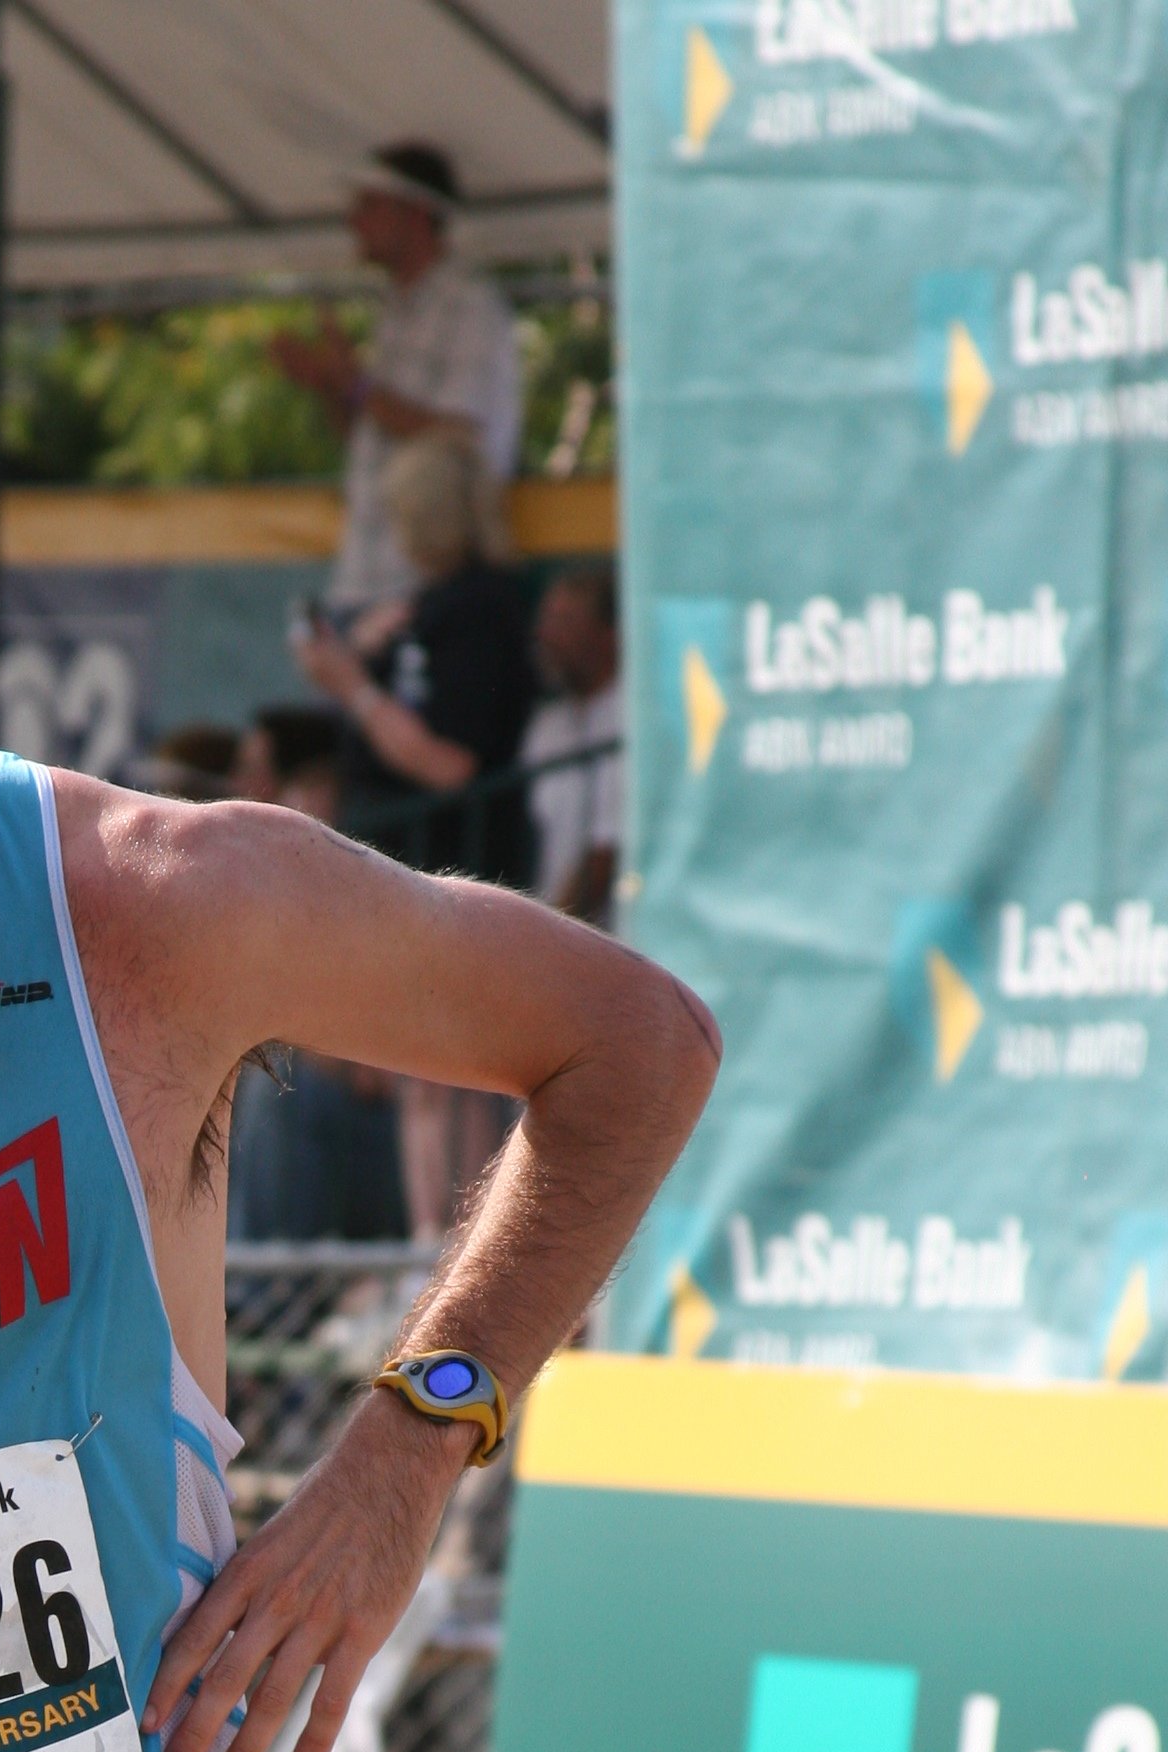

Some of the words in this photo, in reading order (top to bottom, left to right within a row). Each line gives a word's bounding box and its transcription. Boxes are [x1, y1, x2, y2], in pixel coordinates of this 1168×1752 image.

[746, 593, 933, 692] LaSalle
[943, 583, 1069, 684] Bank
[729, 1213, 909, 1307] LaSalle
[915, 1215, 1031, 1308] Bank
